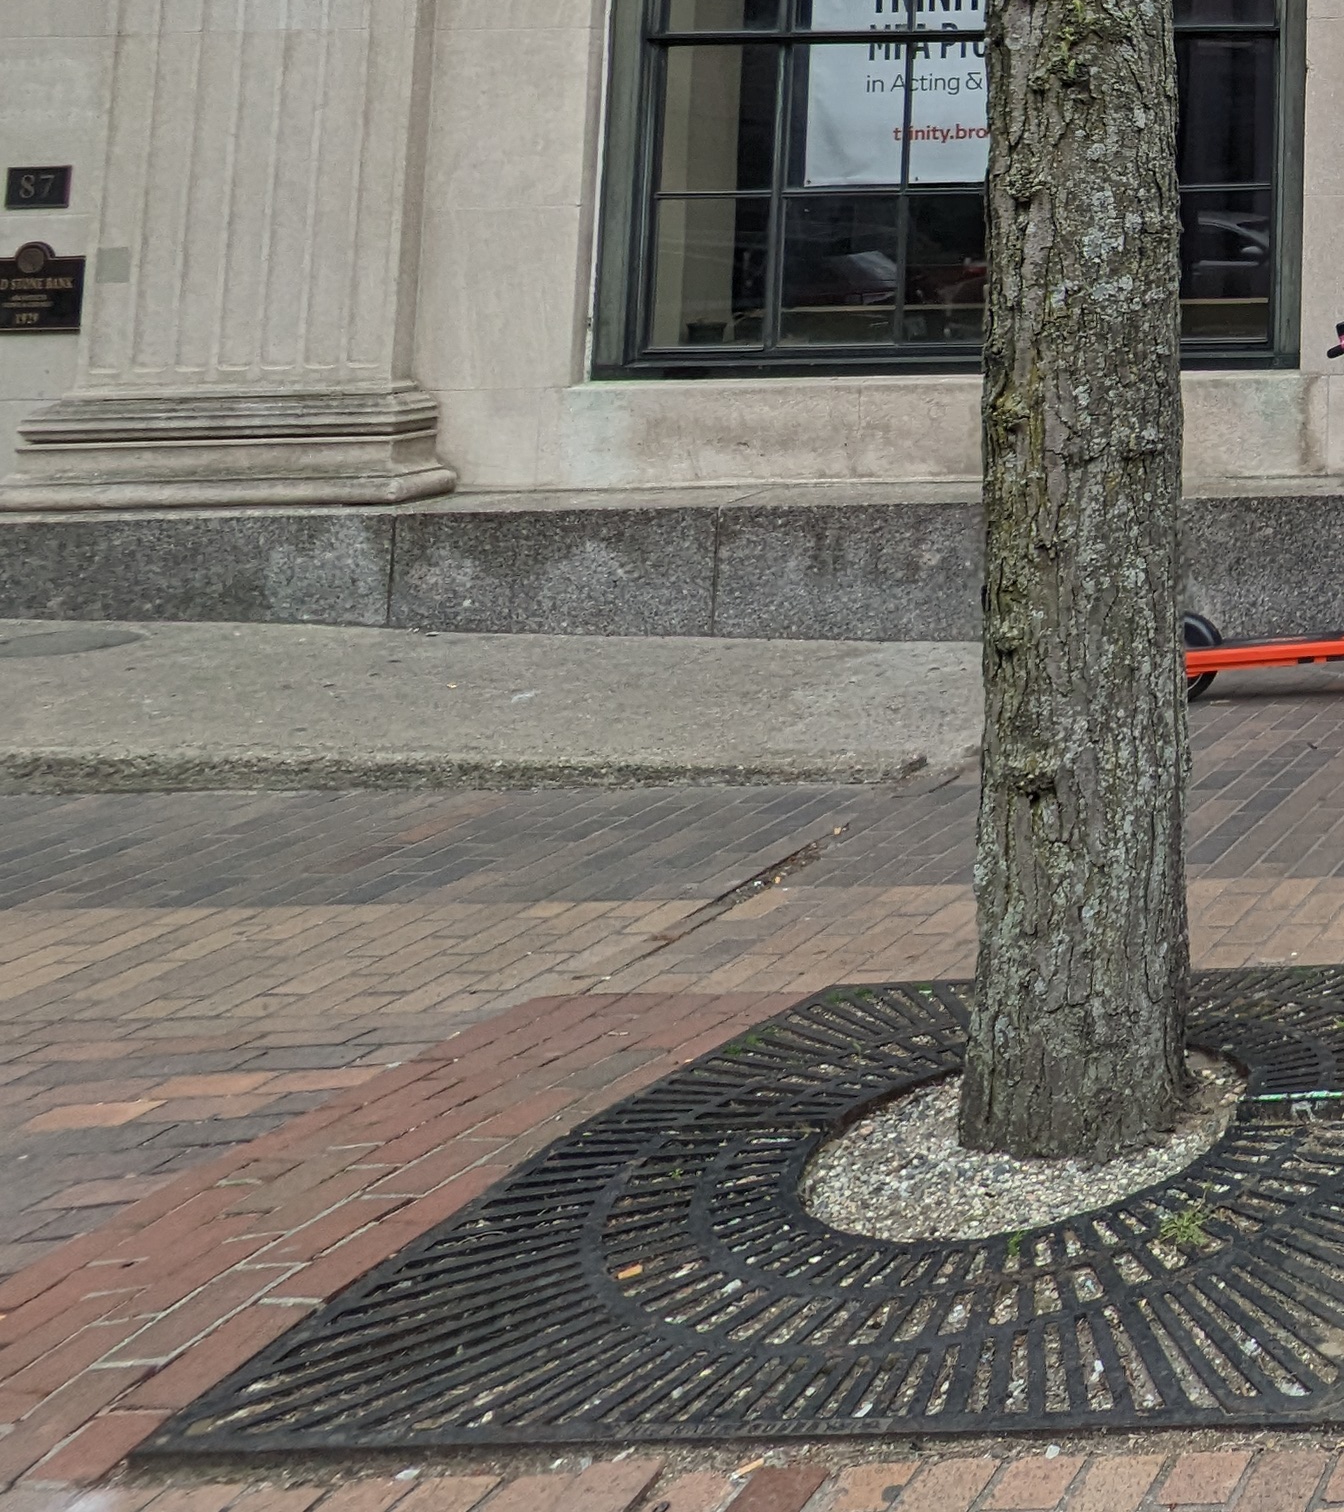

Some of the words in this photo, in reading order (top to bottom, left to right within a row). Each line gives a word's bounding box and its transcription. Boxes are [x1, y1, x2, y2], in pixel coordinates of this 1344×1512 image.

[866, 75, 885, 93] in
[890, 72, 961, 95] Acting
[965, 71, 984, 91] &
[19, 174, 55, 199] 87
